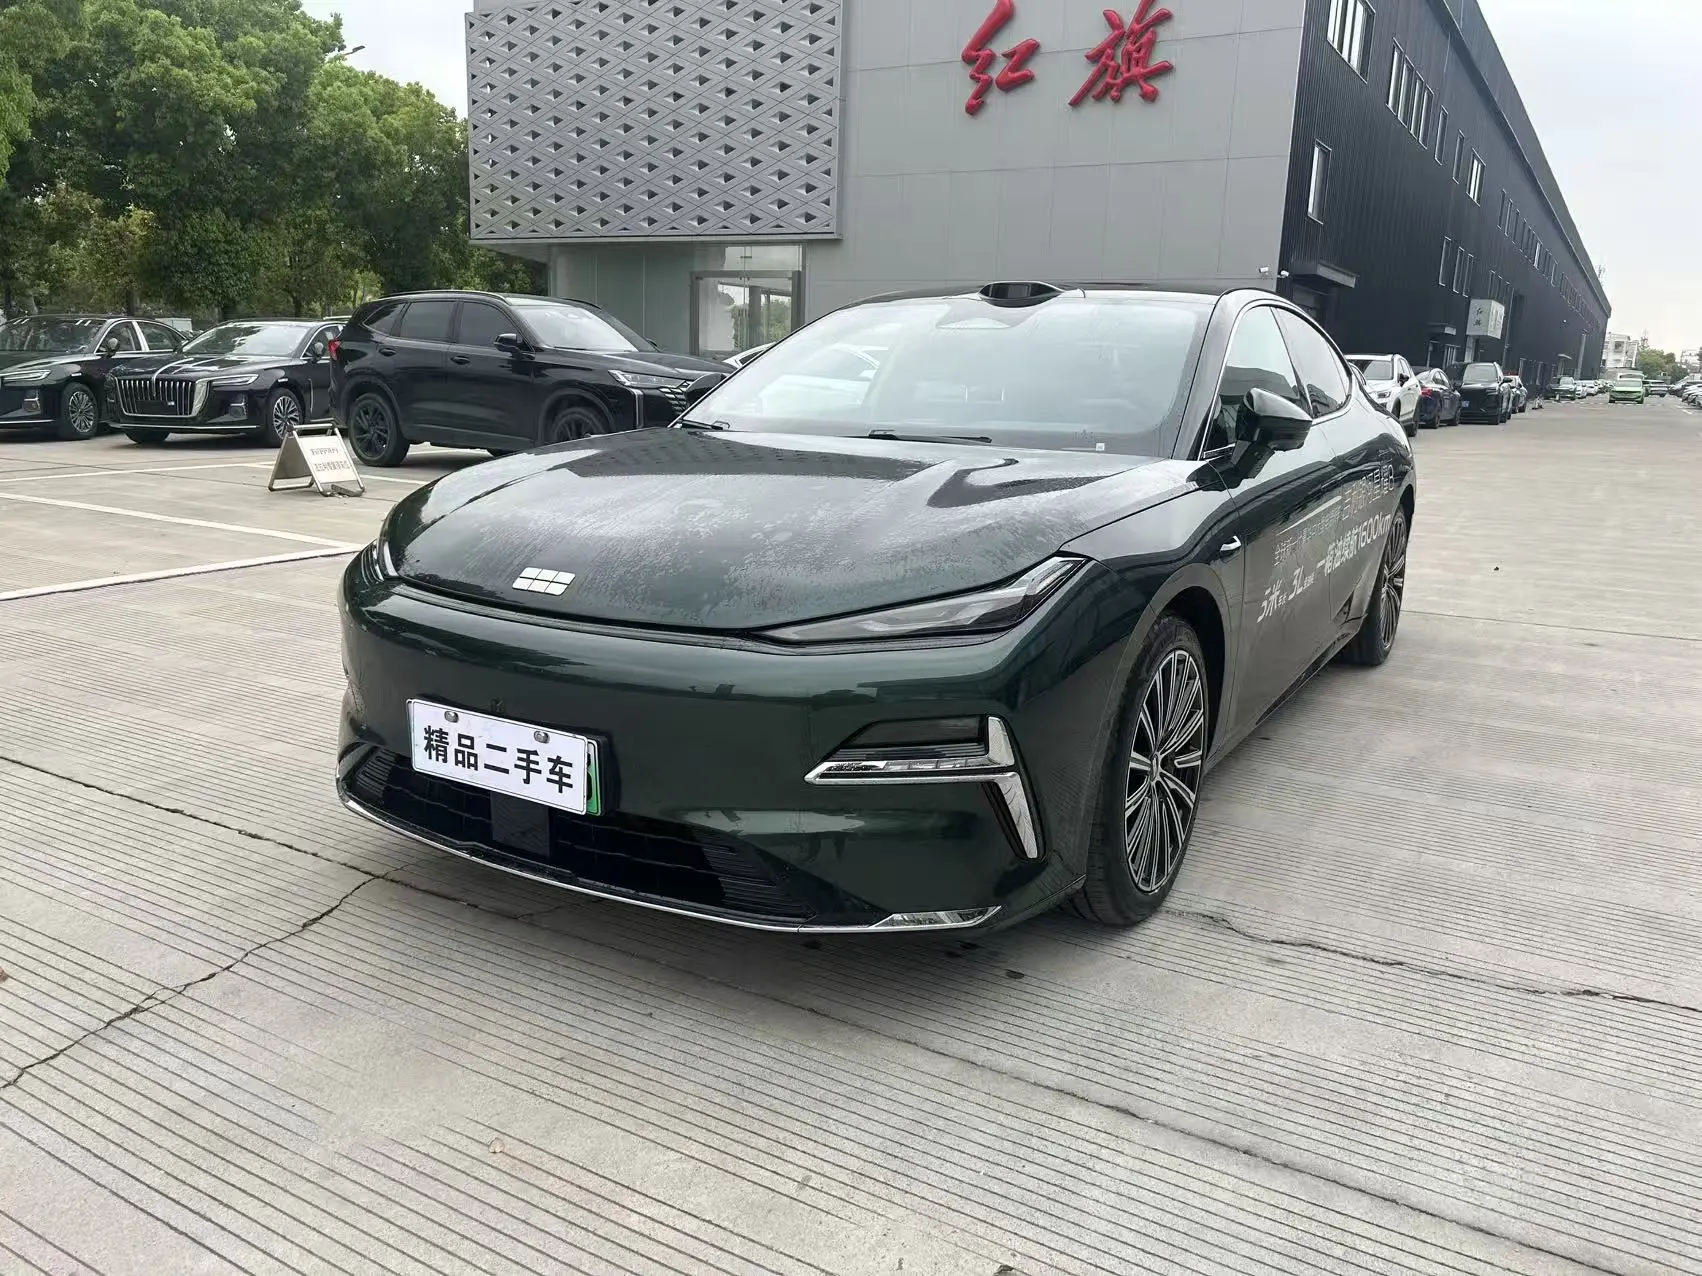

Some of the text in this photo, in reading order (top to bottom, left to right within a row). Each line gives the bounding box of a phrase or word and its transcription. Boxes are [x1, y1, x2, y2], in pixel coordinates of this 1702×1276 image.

[961, 0, 1175, 117] 红旗
[424, 725, 574, 794] 精品二手车
